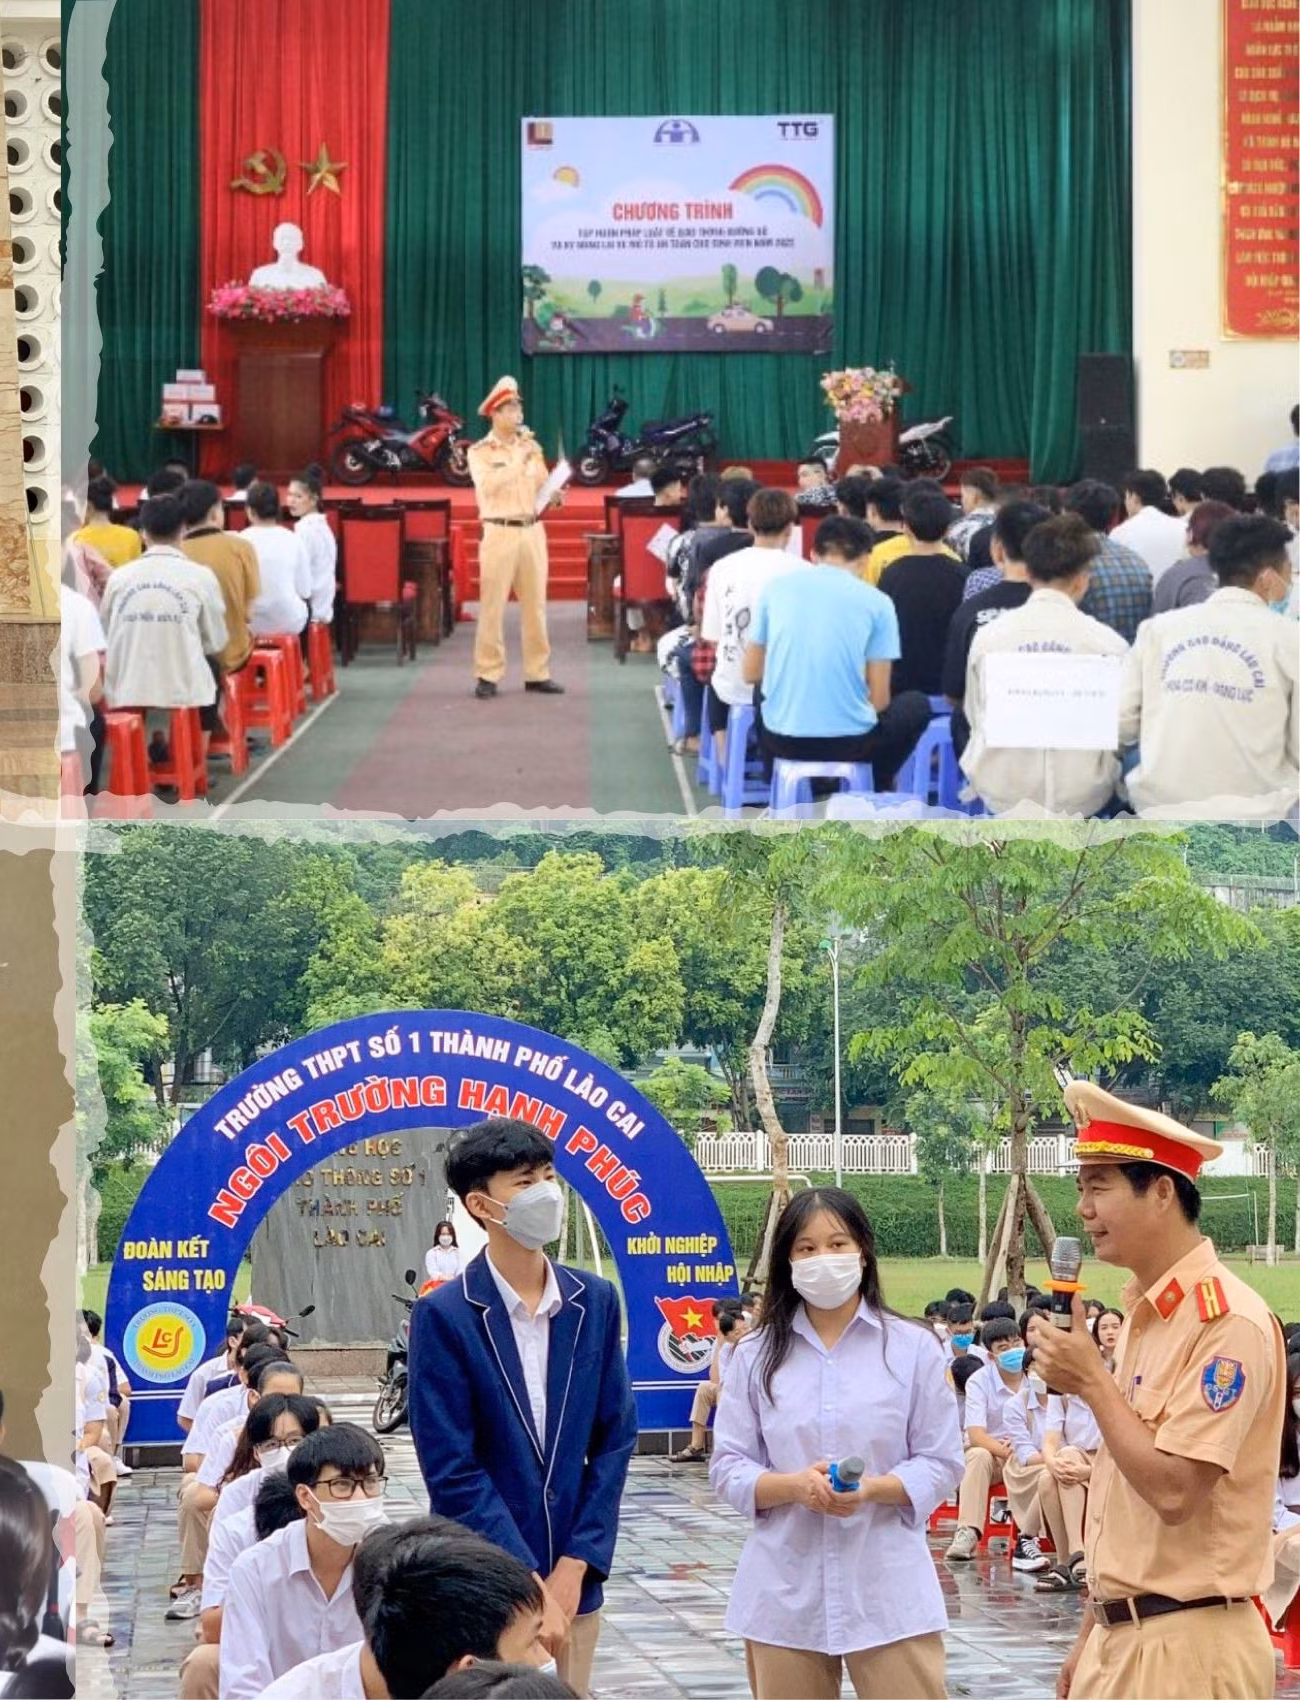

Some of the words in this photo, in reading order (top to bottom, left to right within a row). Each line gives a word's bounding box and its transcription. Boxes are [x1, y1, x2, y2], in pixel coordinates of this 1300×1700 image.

[777, 121, 819, 137] TTG
[612, 202, 680, 221] CHƯƠNG
[684, 199, 733, 221] TRÌNH
[213, 1067, 305, 1141] TRƯỜNG
[301, 1040, 363, 1080] THPT
[368, 1025, 401, 1059] SỐ
[408, 1031, 420, 1053] 1
[430, 1029, 511, 1063] THÀNH
[513, 1045, 570, 1081] PHỐ
[563, 1068, 610, 1109] LÀO
[606, 1100, 646, 1141] CAI
[207, 1131, 293, 1230] NGÔI
[286, 1074, 448, 1145] TRƯỜNG
[564, 1125, 653, 1225] PHÚC
[364, 1138, 403, 1160] HỌC
[320, 1166, 383, 1187] THÔNG
[389, 1162, 416, 1186] SỐ
[296, 1193, 359, 1217] THÀNH
[366, 1191, 405, 1217] PHỐ
[123, 1236, 173, 1260] ĐOÀN
[177, 1234, 210, 1258] KẾT
[313, 1225, 350, 1248] LÀO
[356, 1229, 387, 1248] CAI
[626, 1231, 661, 1255] KHỞI
[665, 1232, 718, 1258] NGHIỆP
[142, 1266, 190, 1292] SÁNG
[193, 1268, 226, 1294] TẠO
[667, 1261, 692, 1287] HỘI
[694, 1261, 735, 1287] NHẬP
